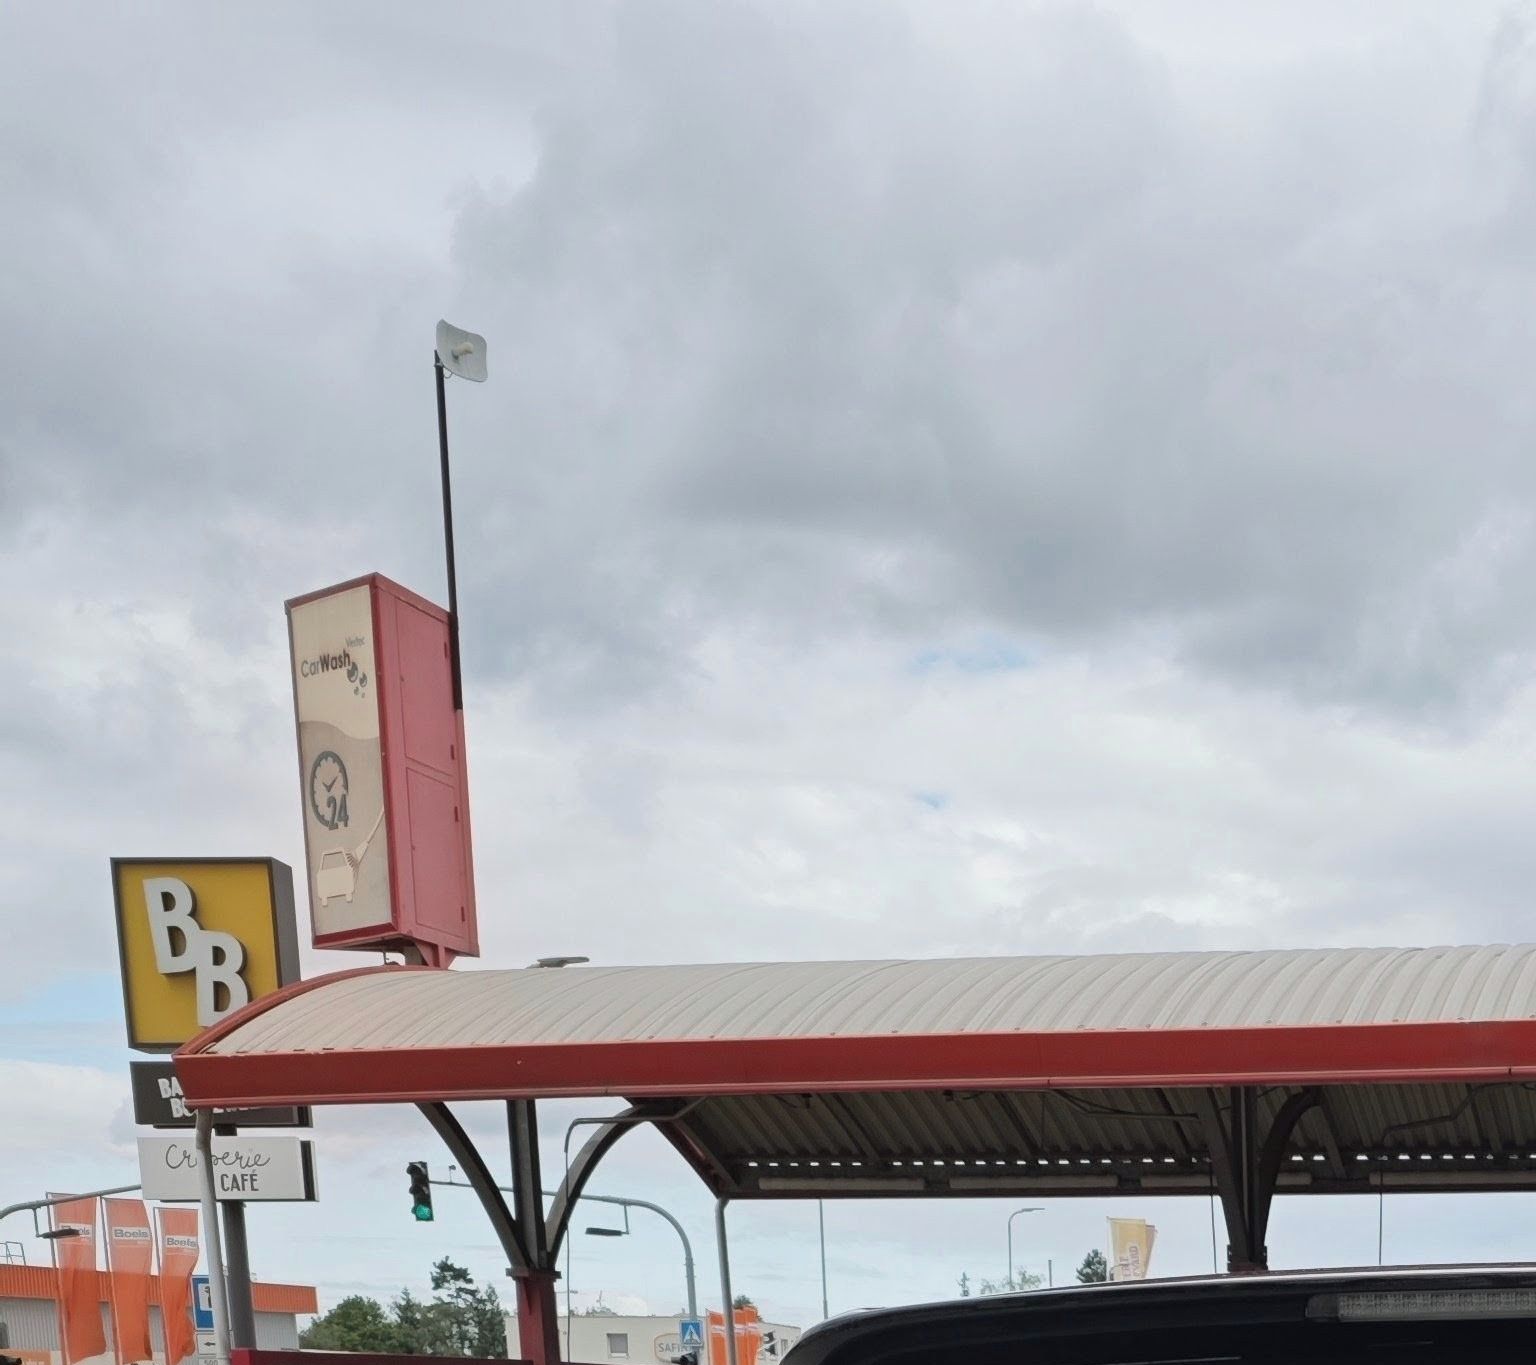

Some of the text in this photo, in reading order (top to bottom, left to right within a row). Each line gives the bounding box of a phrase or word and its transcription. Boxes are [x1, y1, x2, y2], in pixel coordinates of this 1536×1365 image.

[301, 649, 351, 678] CarWash
[327, 793, 349, 830] 24
[220, 1169, 260, 1192] CAFÉ
[114, 1229, 152, 1239] Boels
[166, 1237, 198, 1248] Boels
